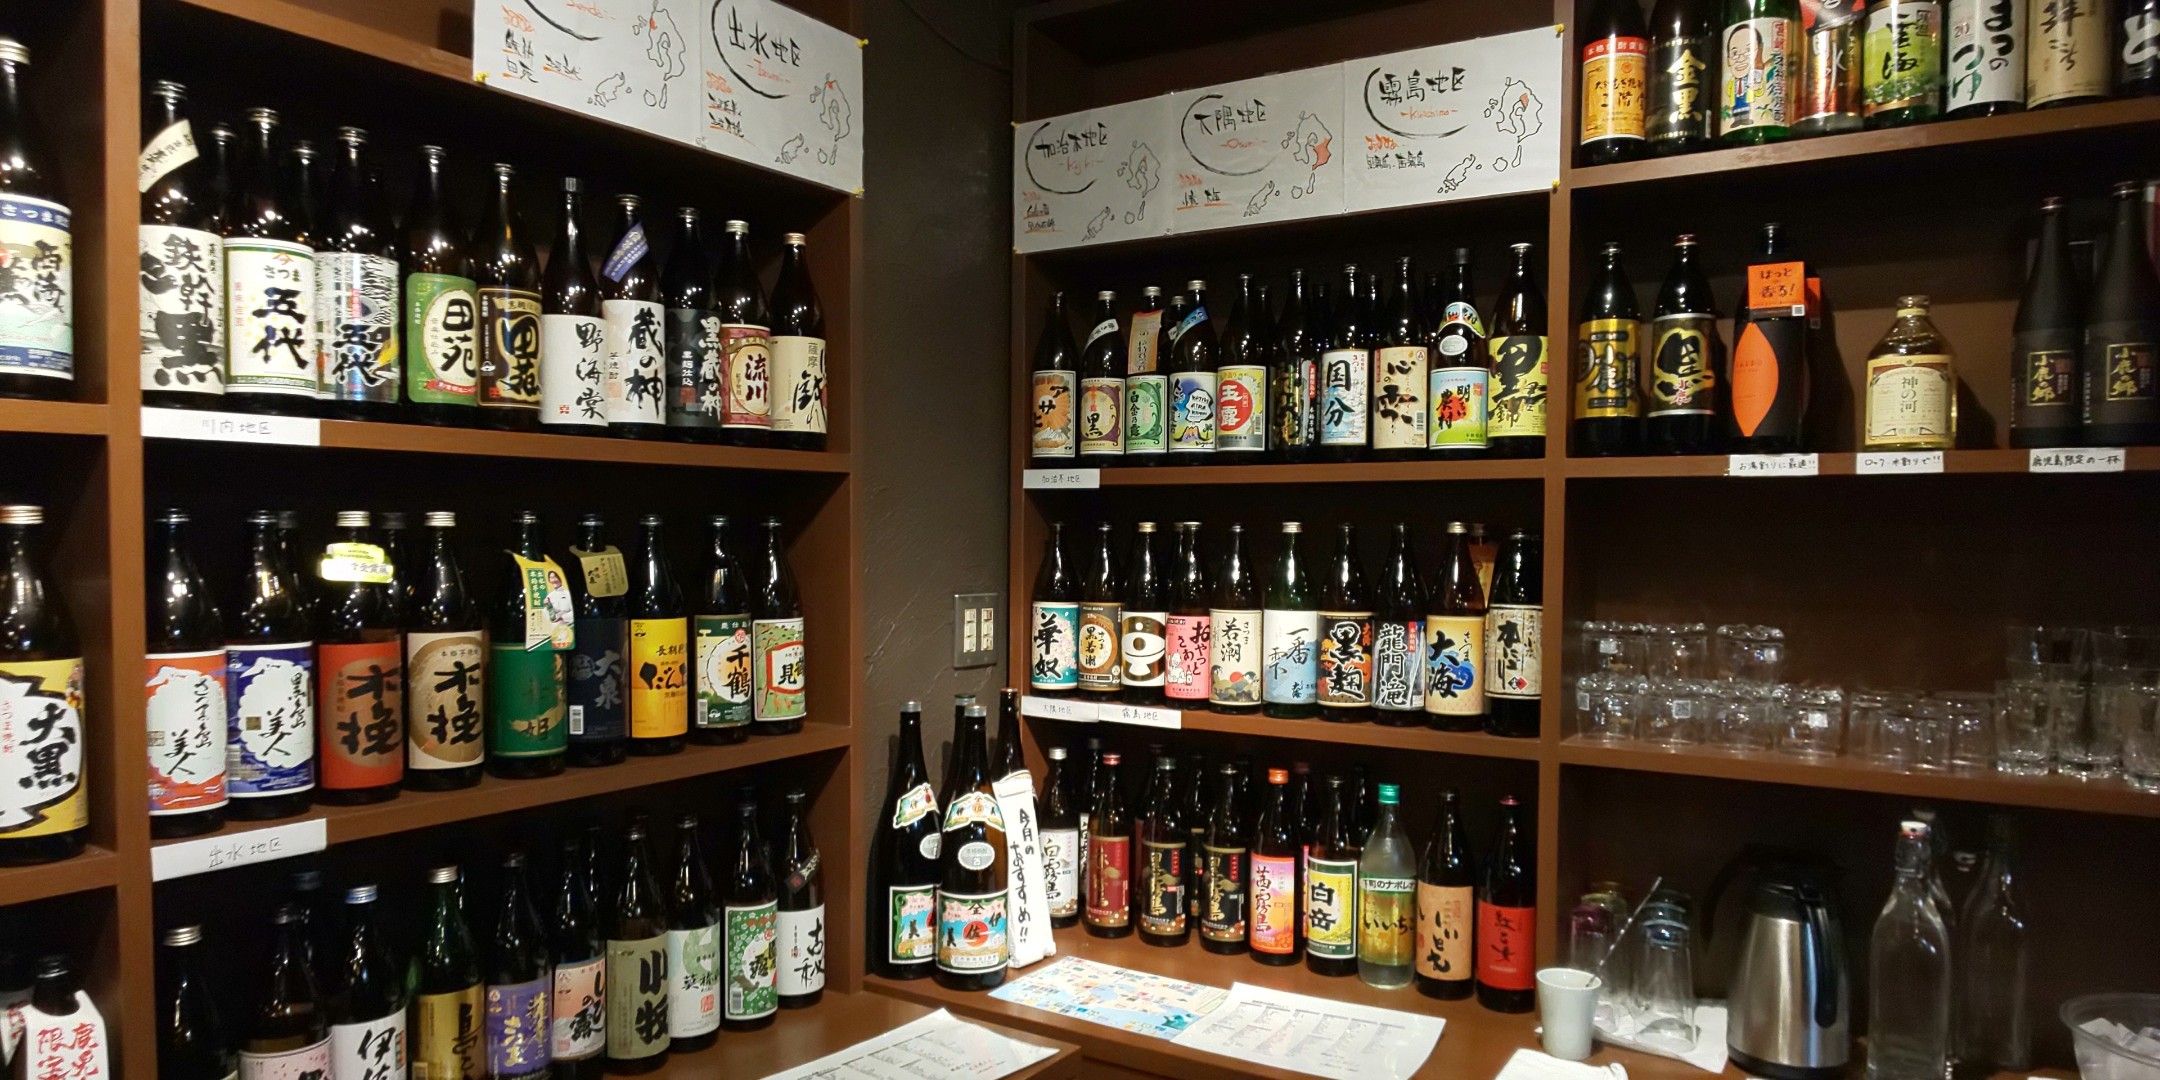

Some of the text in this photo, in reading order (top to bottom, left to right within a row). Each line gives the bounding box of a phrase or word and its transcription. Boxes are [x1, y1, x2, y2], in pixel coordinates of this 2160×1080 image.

[728, 5, 800, 67] 出水地区
[1379, 67, 1465, 106] 霧島地区
[1193, 99, 1267, 136] 大隅地区
[252, 286, 310, 370] 五代
[441, 298, 476, 378] 田苑
[332, 323, 386, 387] 五代
[575, 322, 604, 419] 野海棠
[624, 306, 663, 418] 蔵の神
[745, 353, 768, 403] 流川
[1129, 391, 1141, 437] 白金乃露
[1220, 384, 1243, 426] 玉露
[1325, 359, 1355, 428] 国分
[1900, 375, 1919, 413] 神の河
[1085, 411, 1103, 437] 黒
[2031, 454, 2121, 468] 鹿児島限定の一杯
[1033, 612, 1063, 679] 華奴
[1085, 626, 1097, 666] 黒若潮
[1221, 616, 1242, 663] 若潮
[1286, 627, 1310, 665] 一番
[1328, 622, 1366, 700] 黒麹
[1377, 623, 1408, 706] 龍門滝
[1428, 630, 1463, 698] 大海
[722, 644, 750, 699] 千鶴
[19, 702, 76, 789] 大黒
[164, 728, 197, 776] 美人
[258, 707, 292, 756] 美人
[208, 837, 283, 869] 出水地区
[1018, 807, 1034, 855] 今月の
[1043, 838, 1061, 900] 白霧島
[1255, 865, 1273, 932] 茜霧島
[1308, 882, 1337, 932] 白岳
[634, 947, 669, 1045] 小牧
